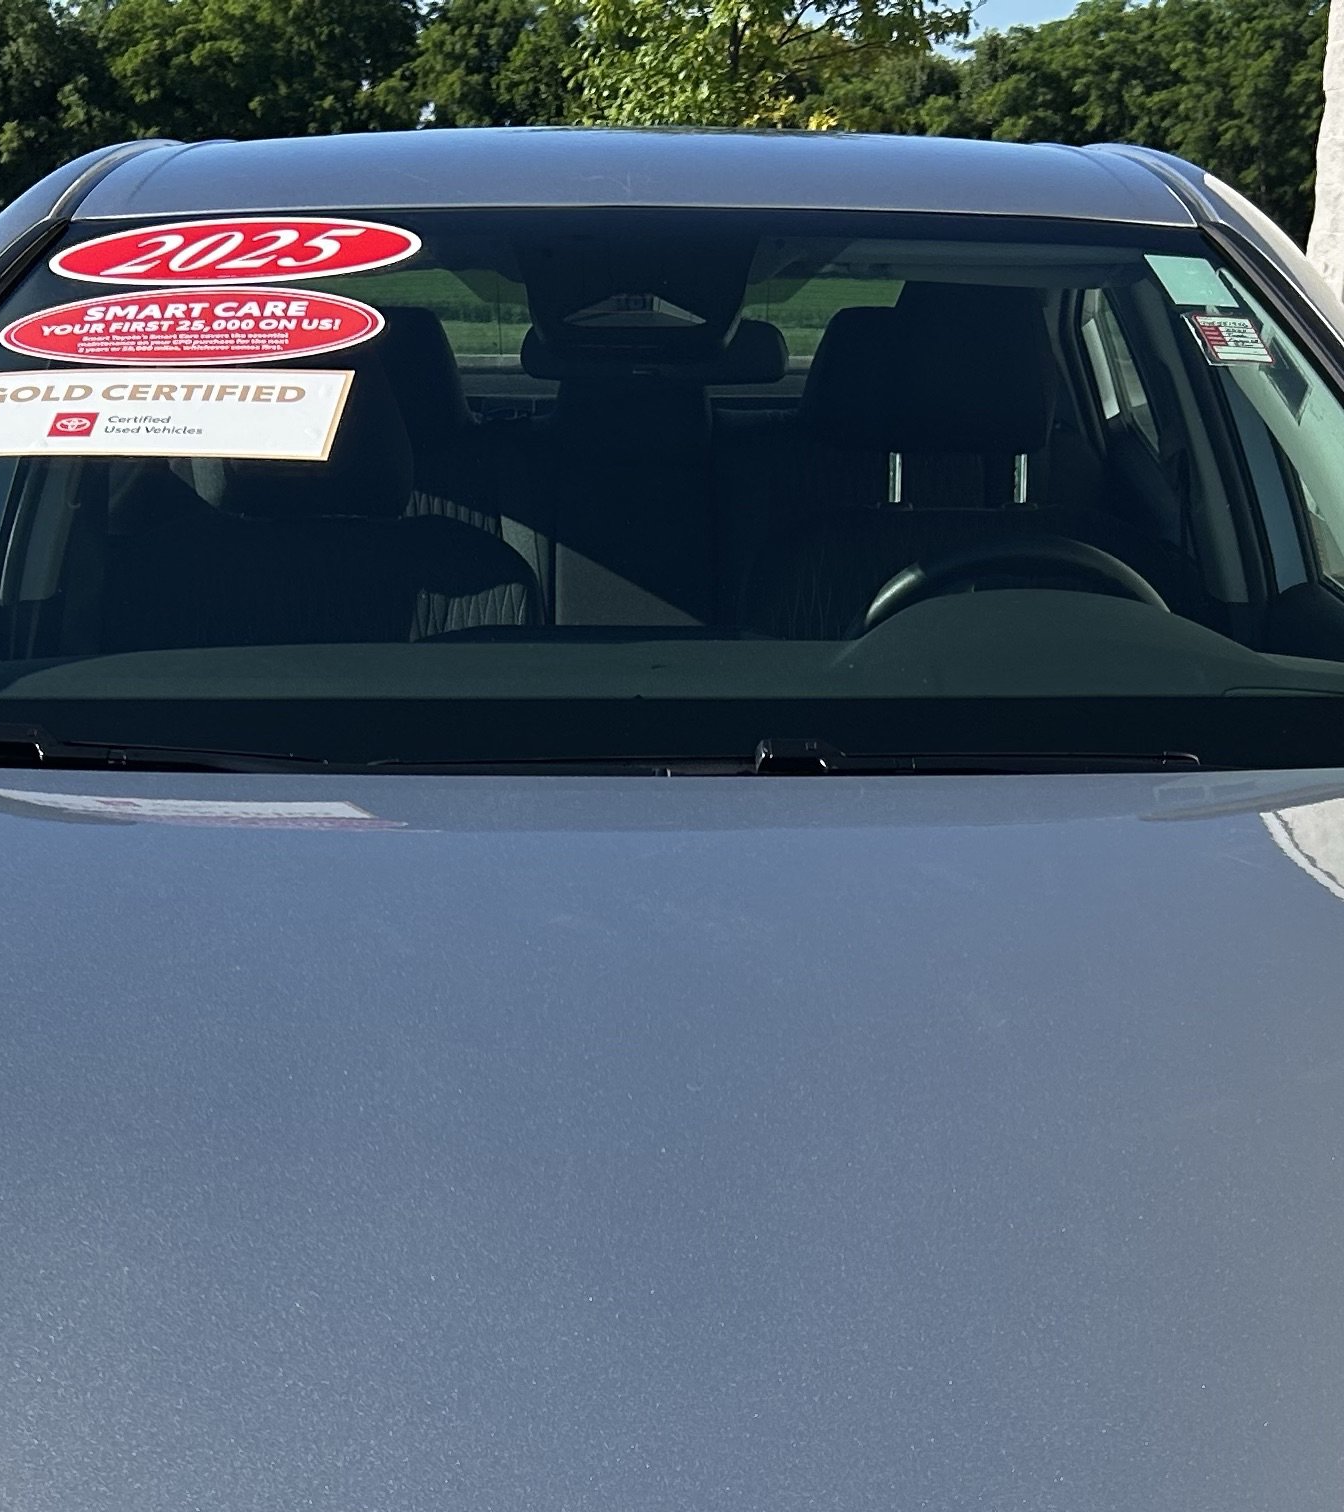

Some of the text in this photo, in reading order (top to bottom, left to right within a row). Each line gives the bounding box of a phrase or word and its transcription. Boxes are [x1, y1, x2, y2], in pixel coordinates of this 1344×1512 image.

[99, 227, 367, 276] 2025
[83, 301, 309, 321] SMART CARE
[41, 318, 342, 337] YOUR FIRST 25,000 ON US!
[101, 383, 306, 404] CERTIFIED
[108, 415, 172, 424] Certified
[104, 425, 203, 435] Used Vehicles
